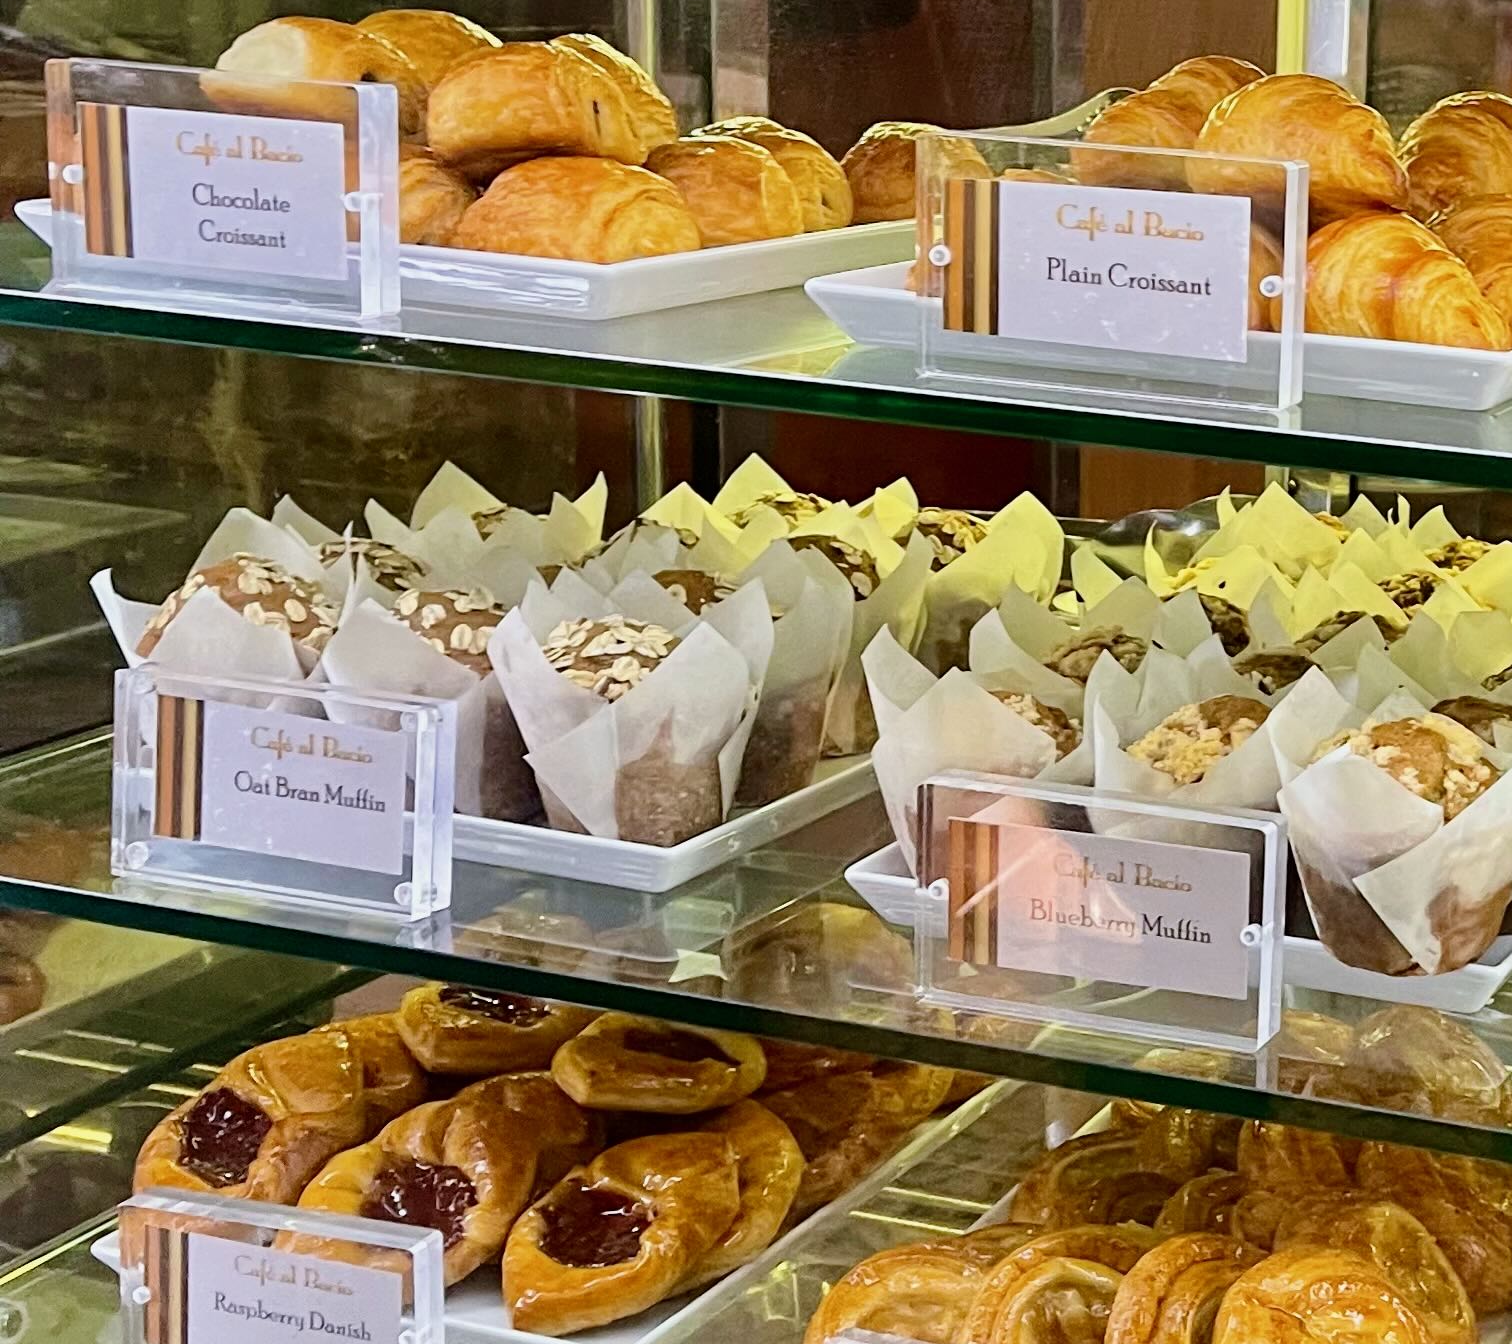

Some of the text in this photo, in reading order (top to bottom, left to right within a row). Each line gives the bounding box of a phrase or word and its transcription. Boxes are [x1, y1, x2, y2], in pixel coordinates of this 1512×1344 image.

[192, 183, 290, 213] Chocolate
[199, 219, 287, 248] Croissant
[1056, 203, 1205, 241] Café al Bacio
[1047, 257, 1212, 296] Plain Croissant
[234, 770, 386, 813] Oat Bran Muffin
[1106, 862, 1124, 884] al
[1134, 862, 1193, 893] Bacio
[1030, 898, 1212, 944] Blueberry Muffin
[214, 1291, 372, 1342] Raspberry Danish
